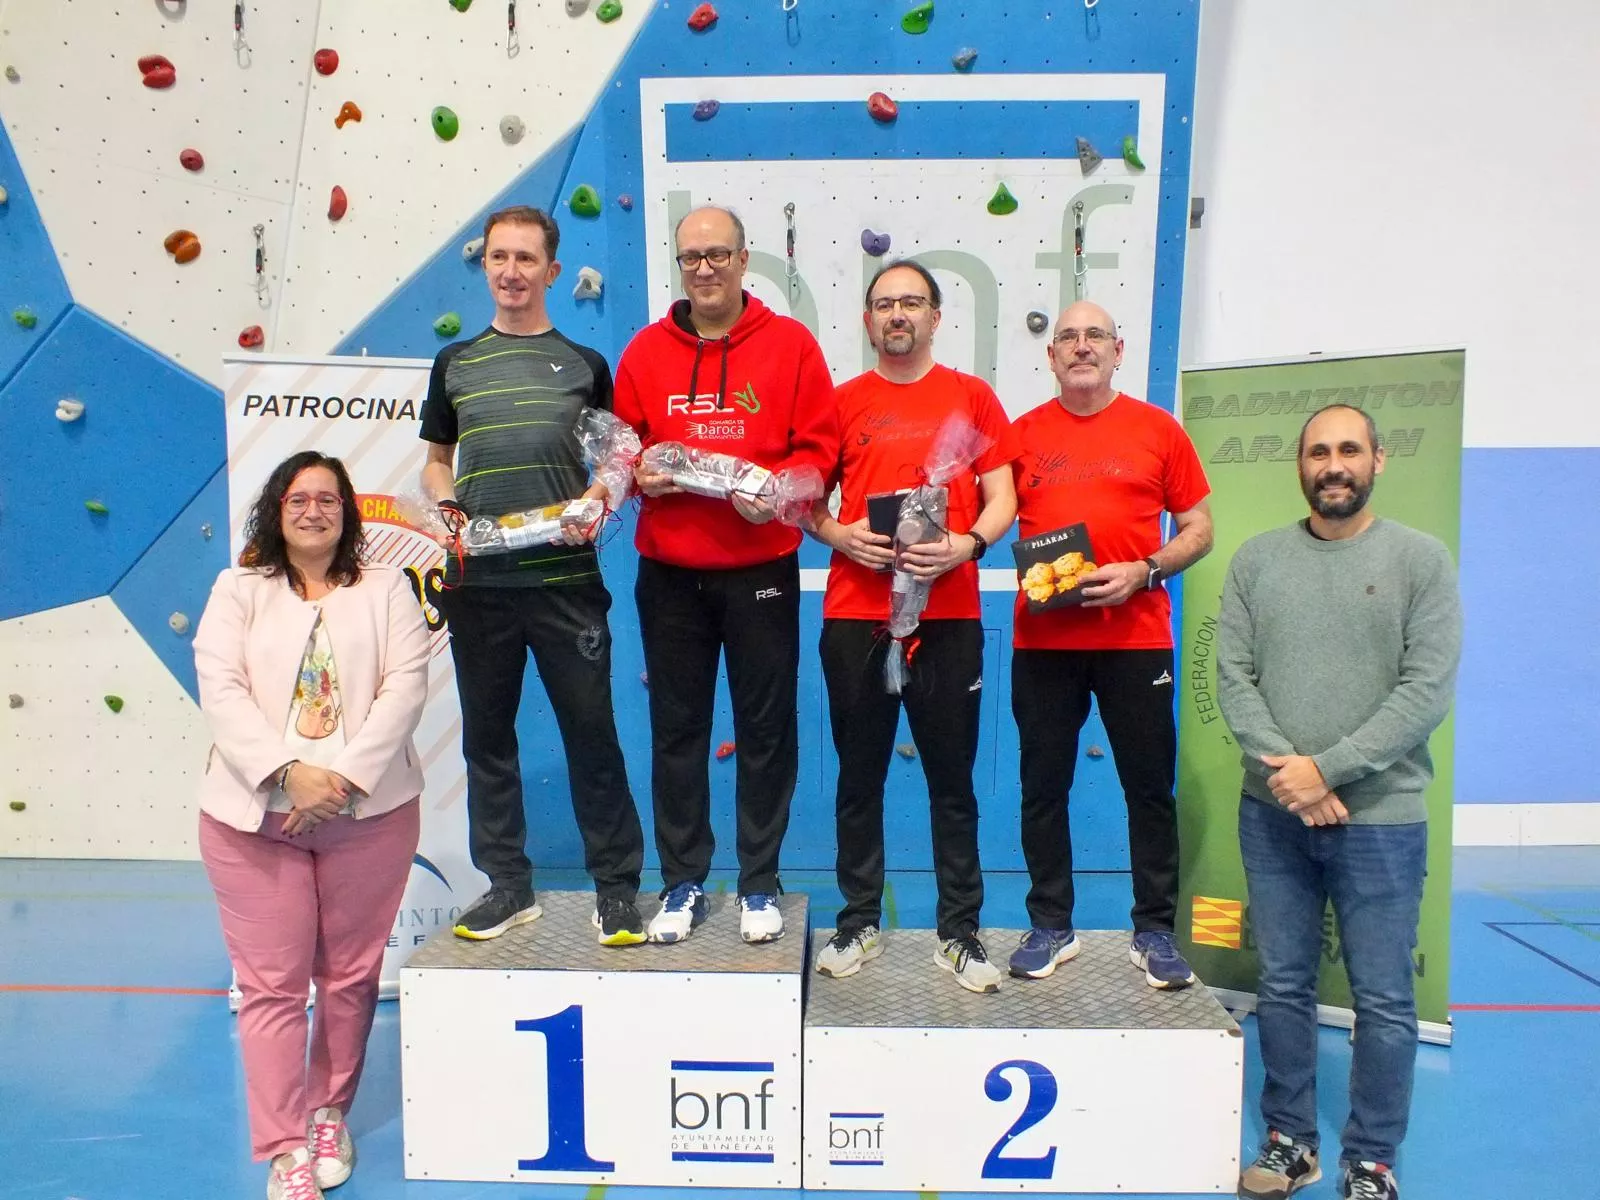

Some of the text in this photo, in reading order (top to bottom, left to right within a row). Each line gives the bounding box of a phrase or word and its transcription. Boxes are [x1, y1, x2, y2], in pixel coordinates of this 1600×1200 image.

[243, 394, 424, 421] PATROCINA
[667, 393, 735, 416] RSL
[1184, 381, 1459, 420] BADMINTON
[698, 424, 745, 435] Daroca
[756, 587, 782, 600] RSL
[1191, 615, 1218, 725] FEDERACION
[515, 1004, 615, 1172] 1
[671, 1077, 774, 1131] bnf
[981, 1059, 1058, 1179] 2
[672, 1134, 774, 1143] AYUNTAMIENTO
[829, 1121, 884, 1149] bnf
